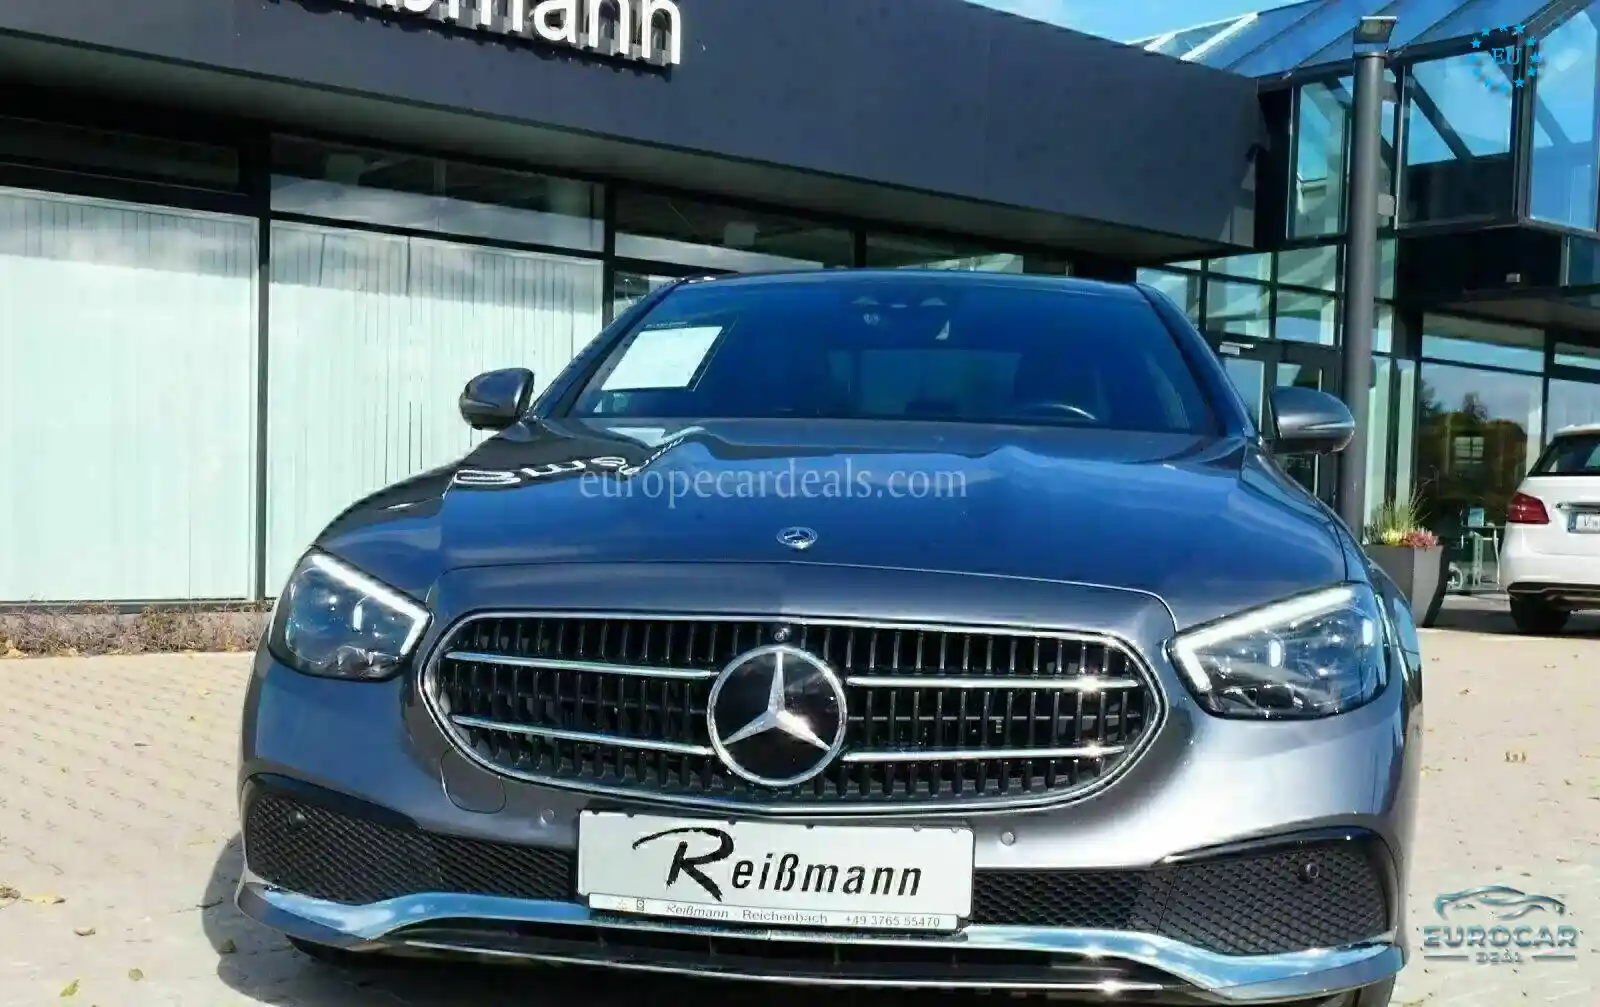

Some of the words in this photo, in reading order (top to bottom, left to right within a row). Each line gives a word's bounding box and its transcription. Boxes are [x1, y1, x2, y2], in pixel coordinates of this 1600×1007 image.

[632, 826, 923, 902] Reißmann
[742, 909, 828, 924] Reichenbach
[845, 914, 867, 926] +49
[871, 915, 900, 926] 3765
[903, 916, 941, 928] 55470
